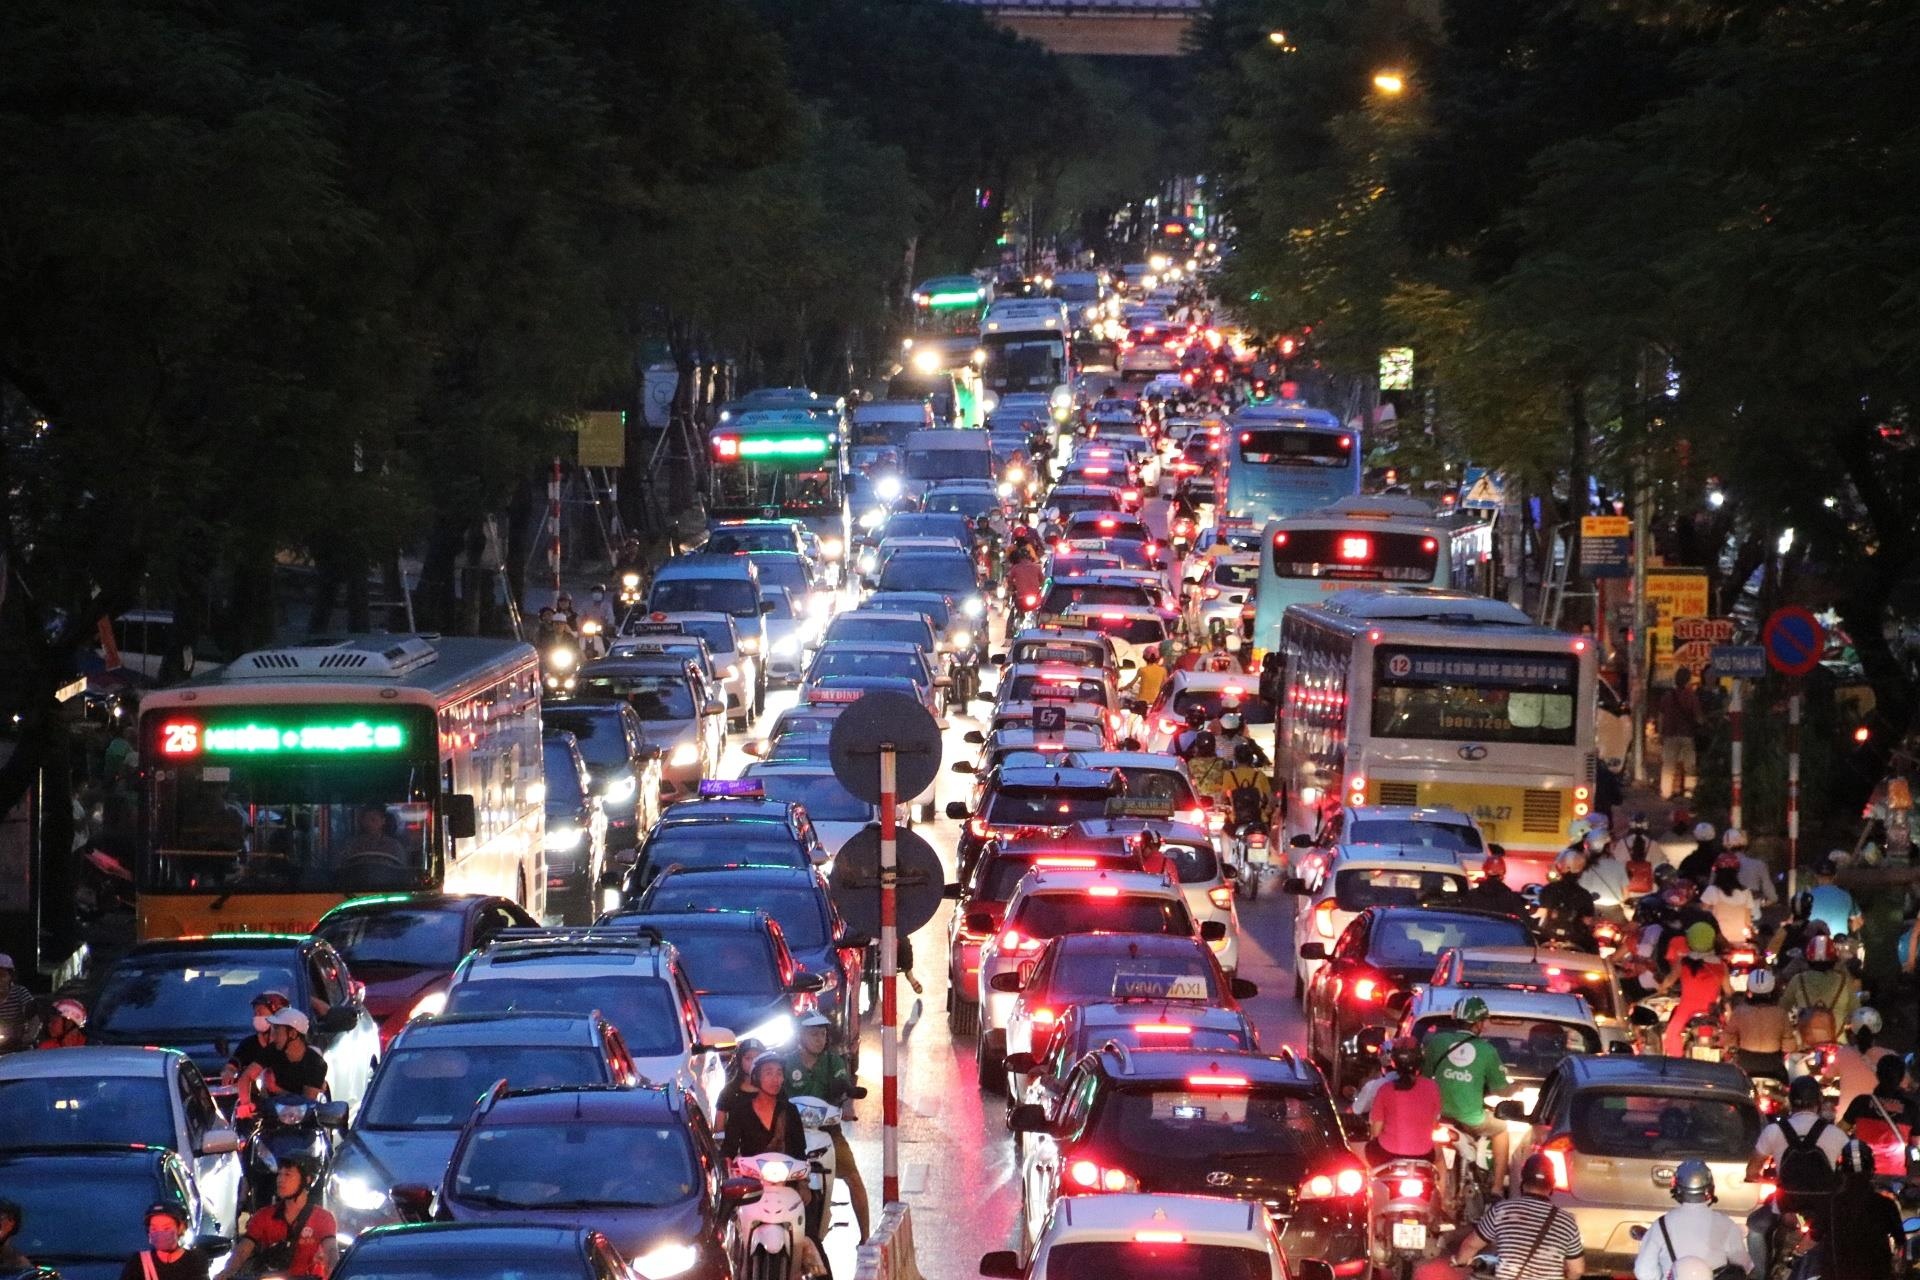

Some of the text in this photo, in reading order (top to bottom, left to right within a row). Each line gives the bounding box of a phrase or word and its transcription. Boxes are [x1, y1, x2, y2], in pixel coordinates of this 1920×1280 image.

[1392, 658, 1409, 672] 12
[164, 725, 197, 752] 26
[1443, 1068, 1473, 1083] Grab
